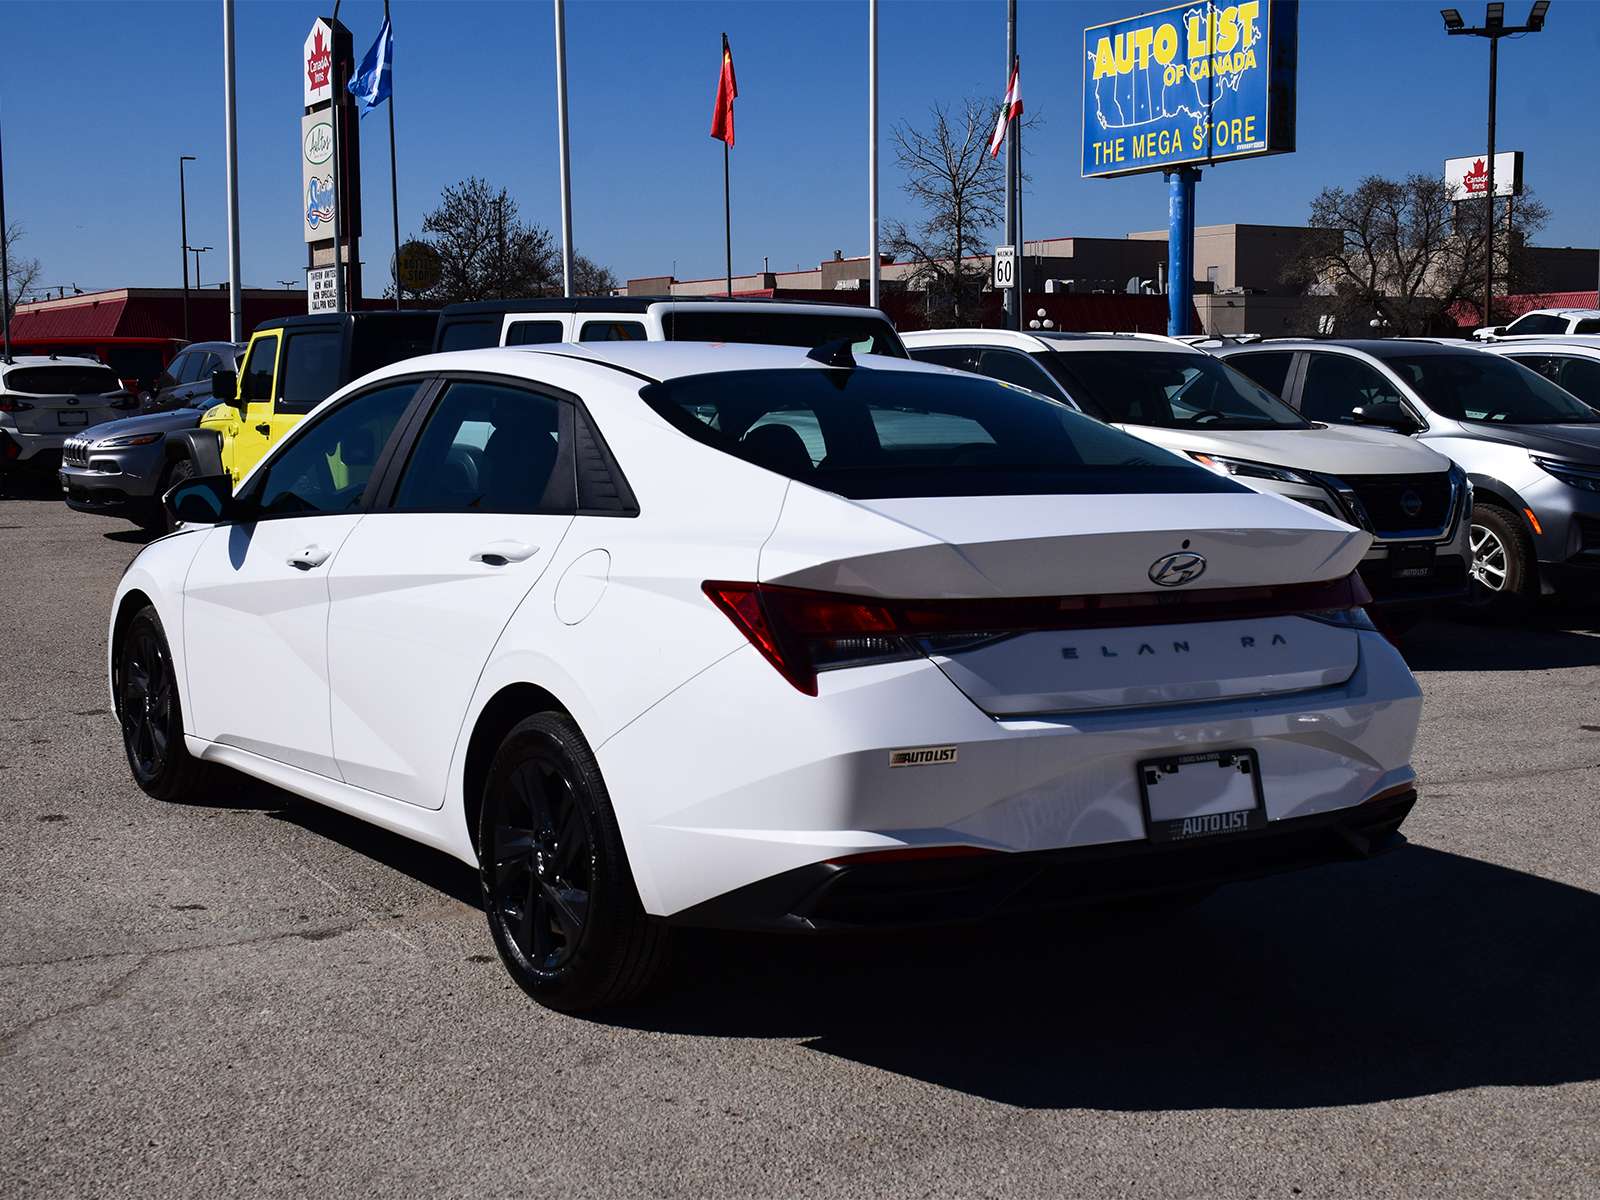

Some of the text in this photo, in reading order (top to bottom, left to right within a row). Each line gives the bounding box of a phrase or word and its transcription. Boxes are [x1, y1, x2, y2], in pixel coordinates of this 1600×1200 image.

[1093, 1, 1260, 80] AUTO LIST
[314, 71, 325, 83] Inns
[1163, 50, 1257, 86] OF CANADA
[1093, 116, 1256, 166] THE MEGA STORE
[997, 260, 1012, 282] 60
